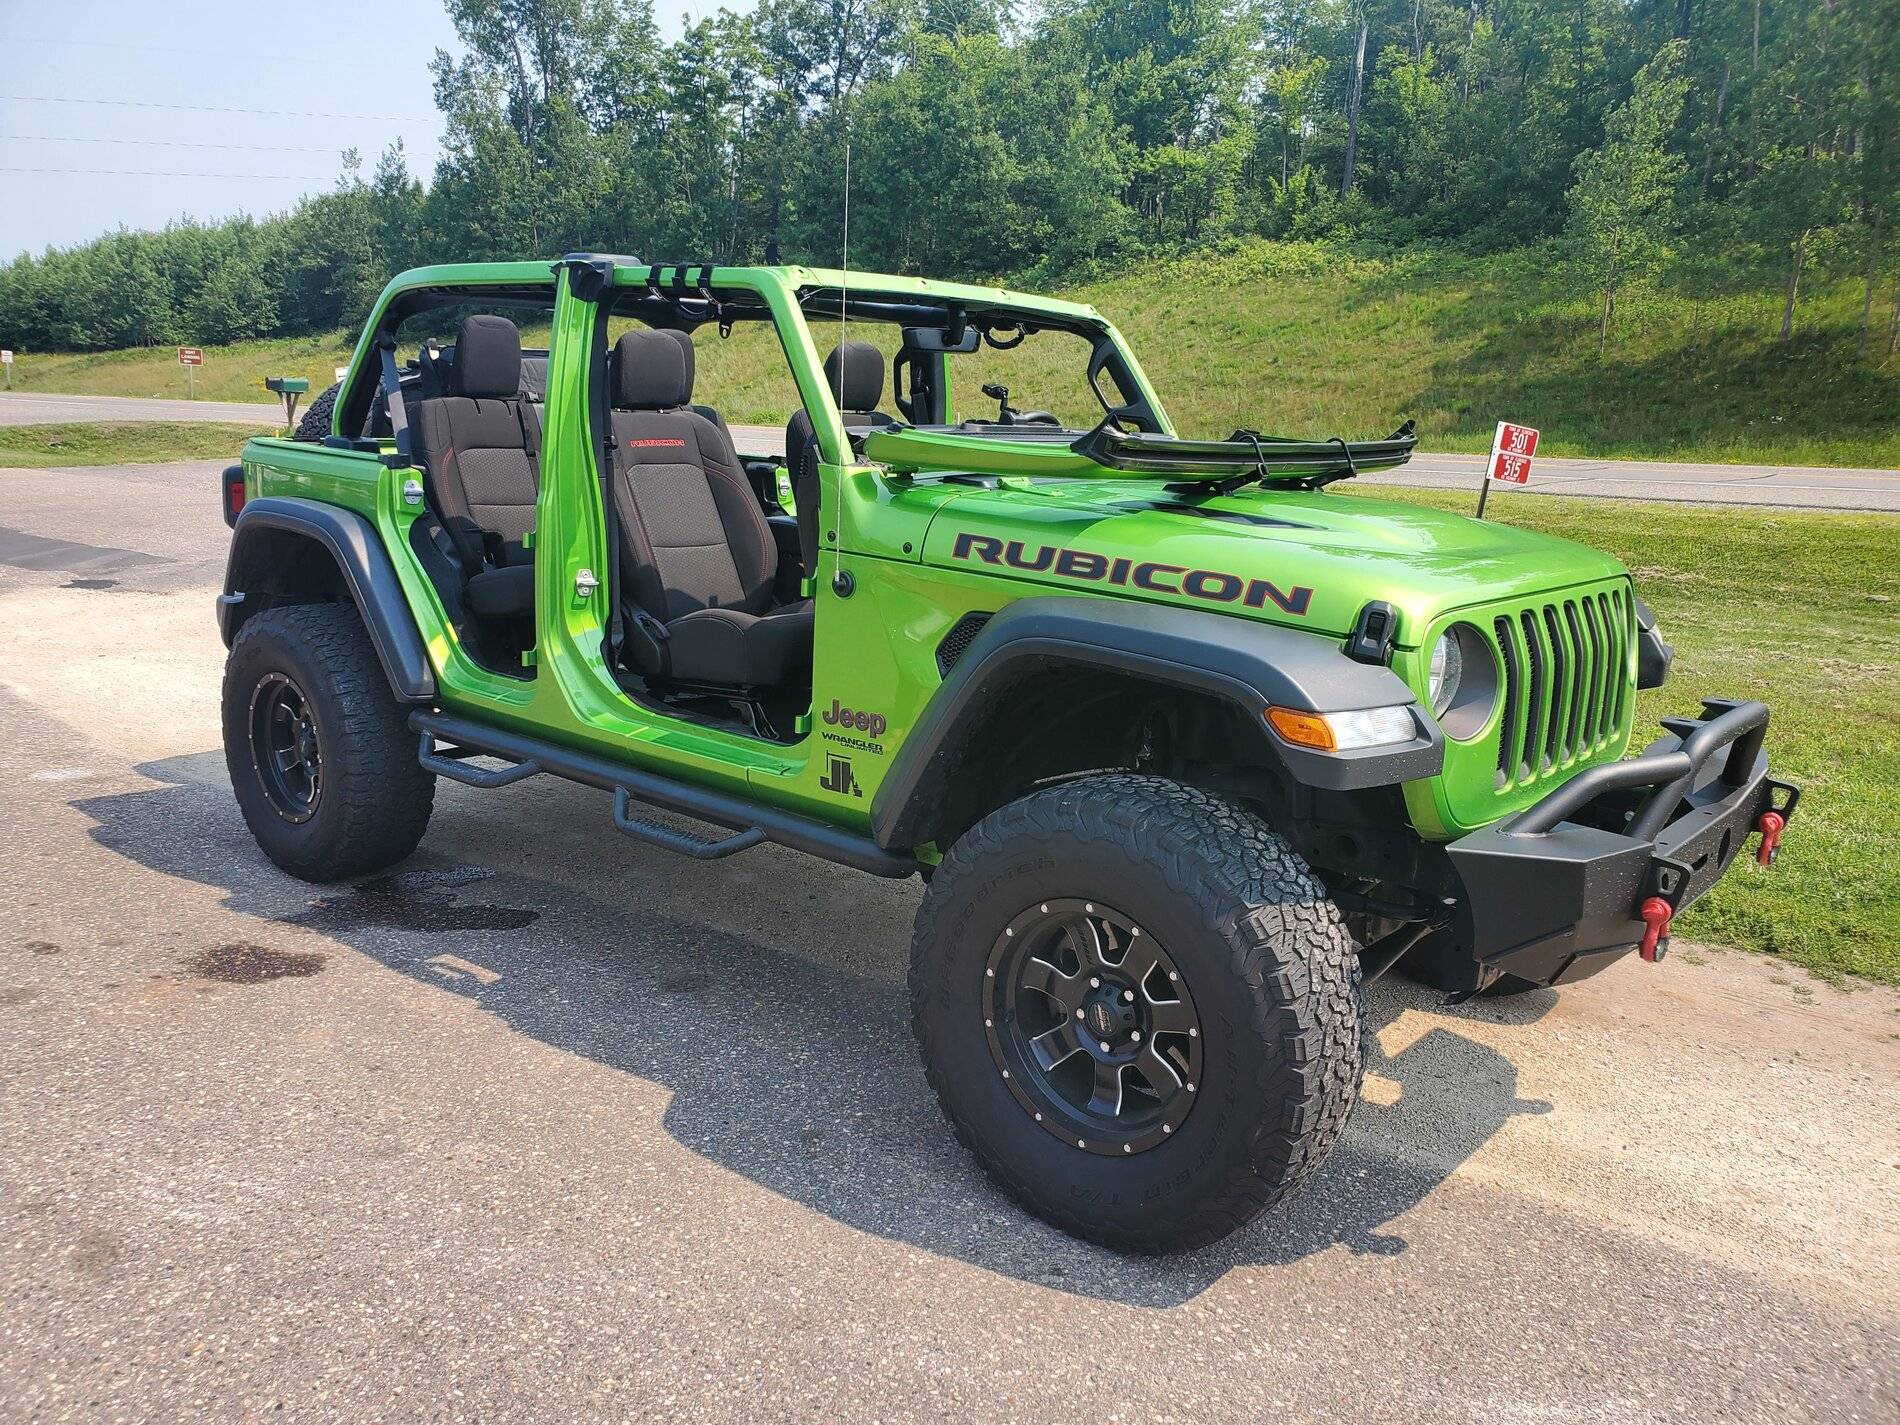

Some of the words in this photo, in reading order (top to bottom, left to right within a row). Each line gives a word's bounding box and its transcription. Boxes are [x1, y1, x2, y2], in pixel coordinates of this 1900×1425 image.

[1510, 431, 1529, 450] 501
[1504, 460, 1522, 478] 515
[951, 532, 1315, 617] RUBICON
[822, 698, 887, 739] Jeep
[822, 731, 884, 752] WRANGLER
[840, 742, 884, 756] UNLIMITED
